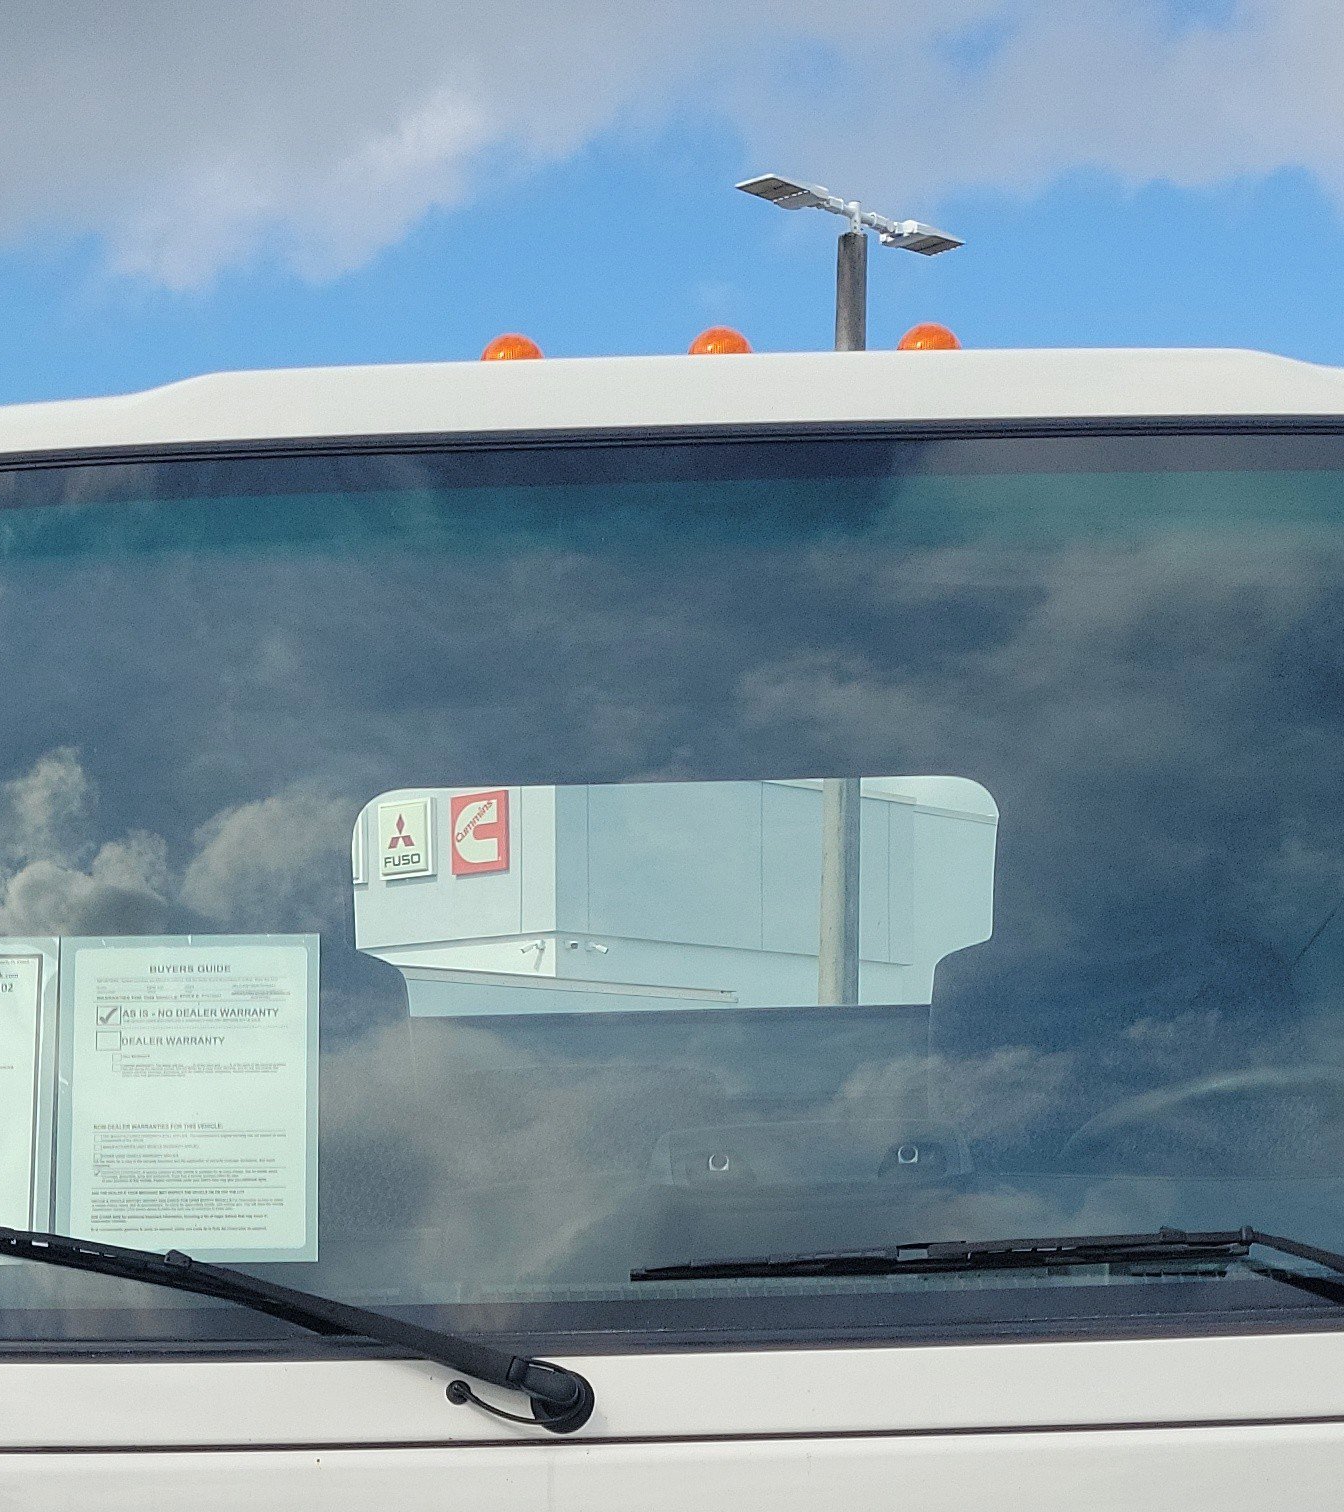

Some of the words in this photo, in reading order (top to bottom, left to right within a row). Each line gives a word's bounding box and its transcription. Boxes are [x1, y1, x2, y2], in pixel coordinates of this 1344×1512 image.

[456, 800, 493, 843] Cummins
[384, 853, 421, 868] FUSO
[149, 965, 195, 974] BUYERS
[197, 964, 232, 973] GUIDE
[158, 1009, 173, 1018] NO
[176, 1008, 218, 1018] DEALER
[219, 1008, 279, 1017] WARRANTY
[121, 1037, 164, 1046] DEALER
[166, 1036, 225, 1045] WARRANTY
